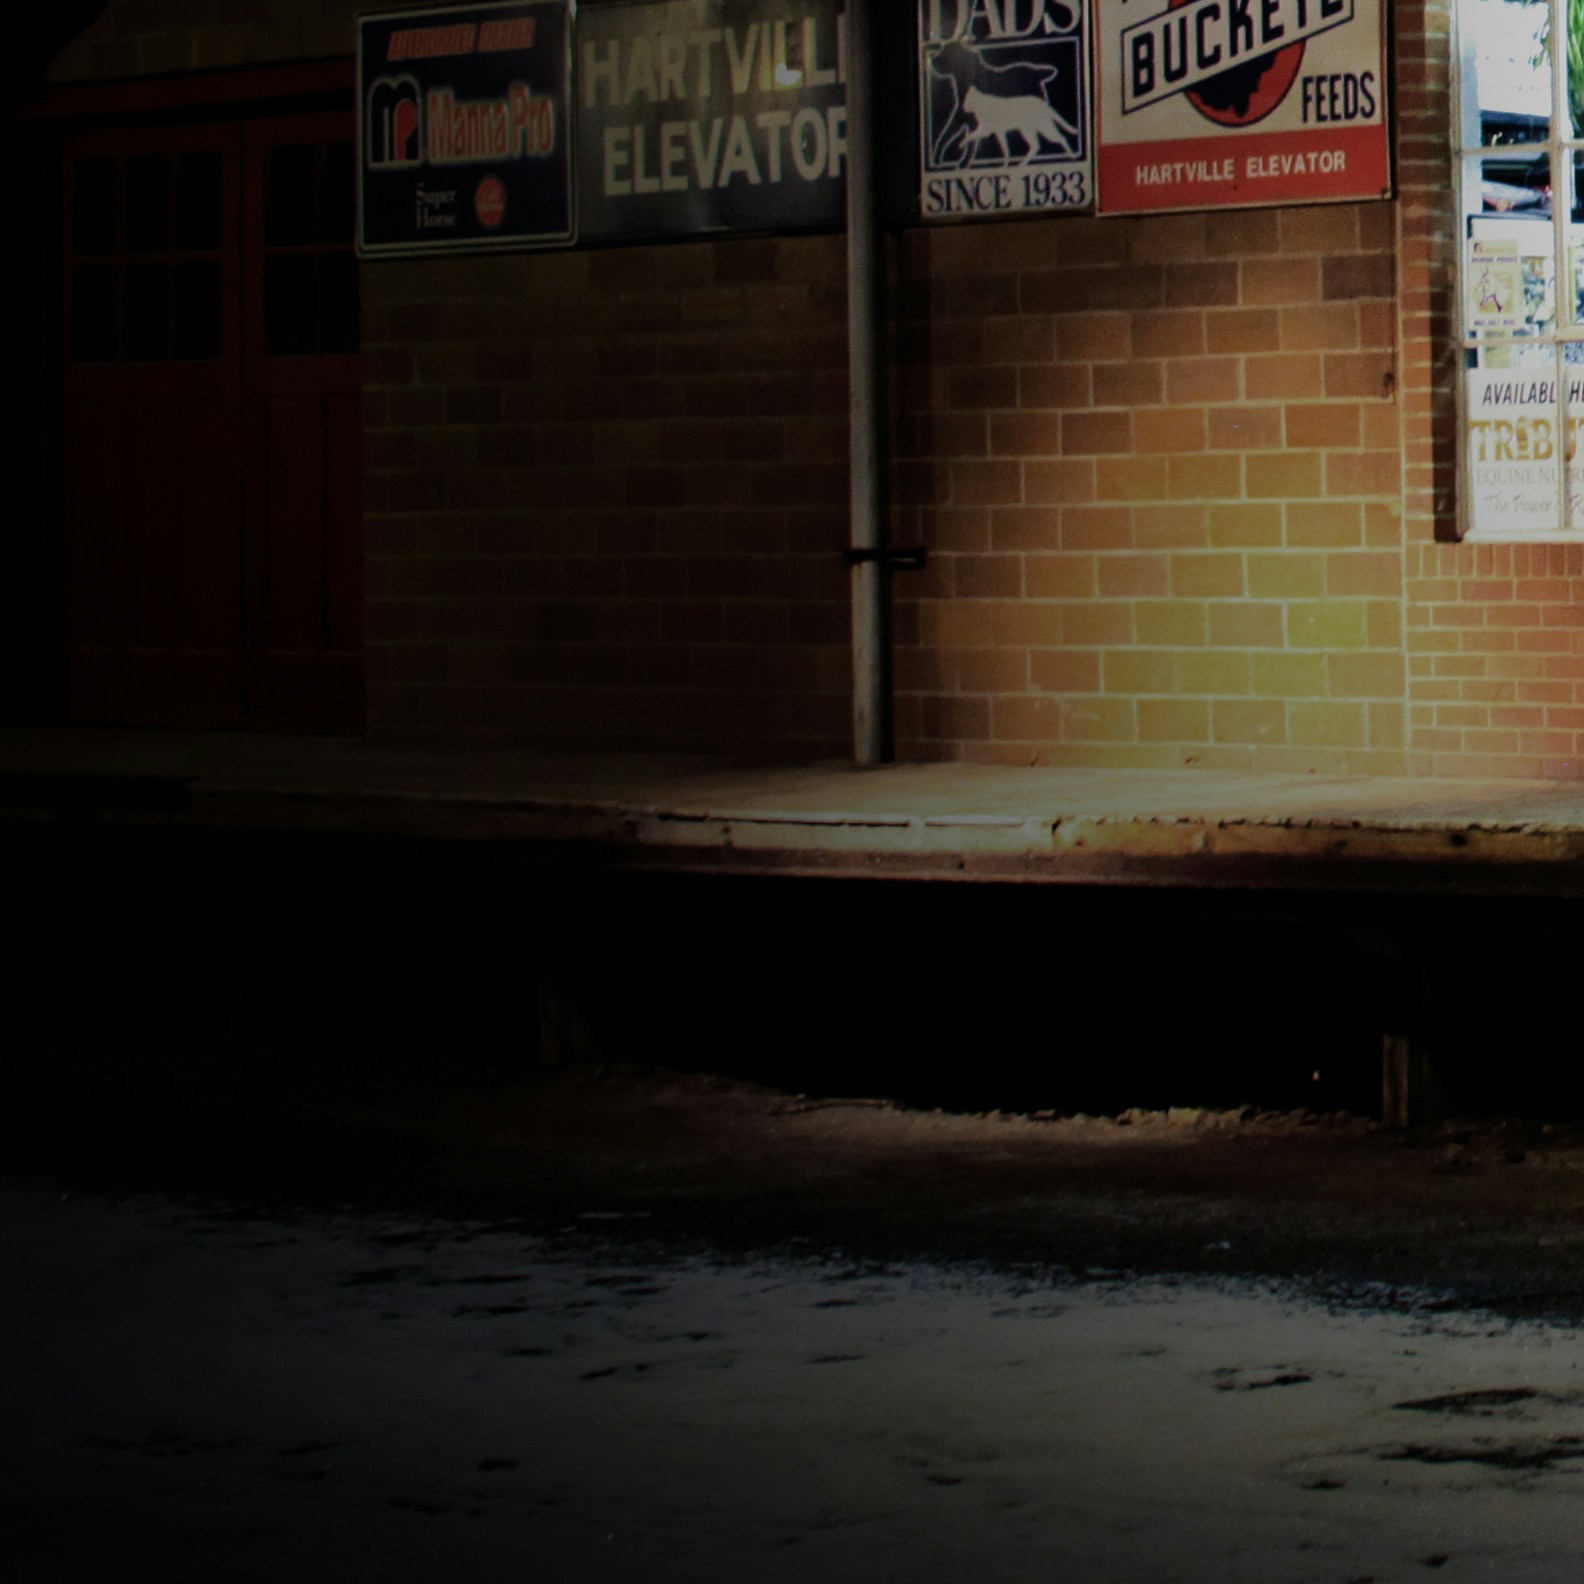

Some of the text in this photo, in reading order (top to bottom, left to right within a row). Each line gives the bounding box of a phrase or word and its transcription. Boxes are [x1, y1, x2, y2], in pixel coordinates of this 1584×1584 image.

[1302, 70, 1377, 124] FEEDS
[1134, 150, 1347, 186] HARTVILLE ELEVATOR
[927, 171, 1086, 213] SINCE 1933
[1482, 380, 1557, 406] AVAILABL
